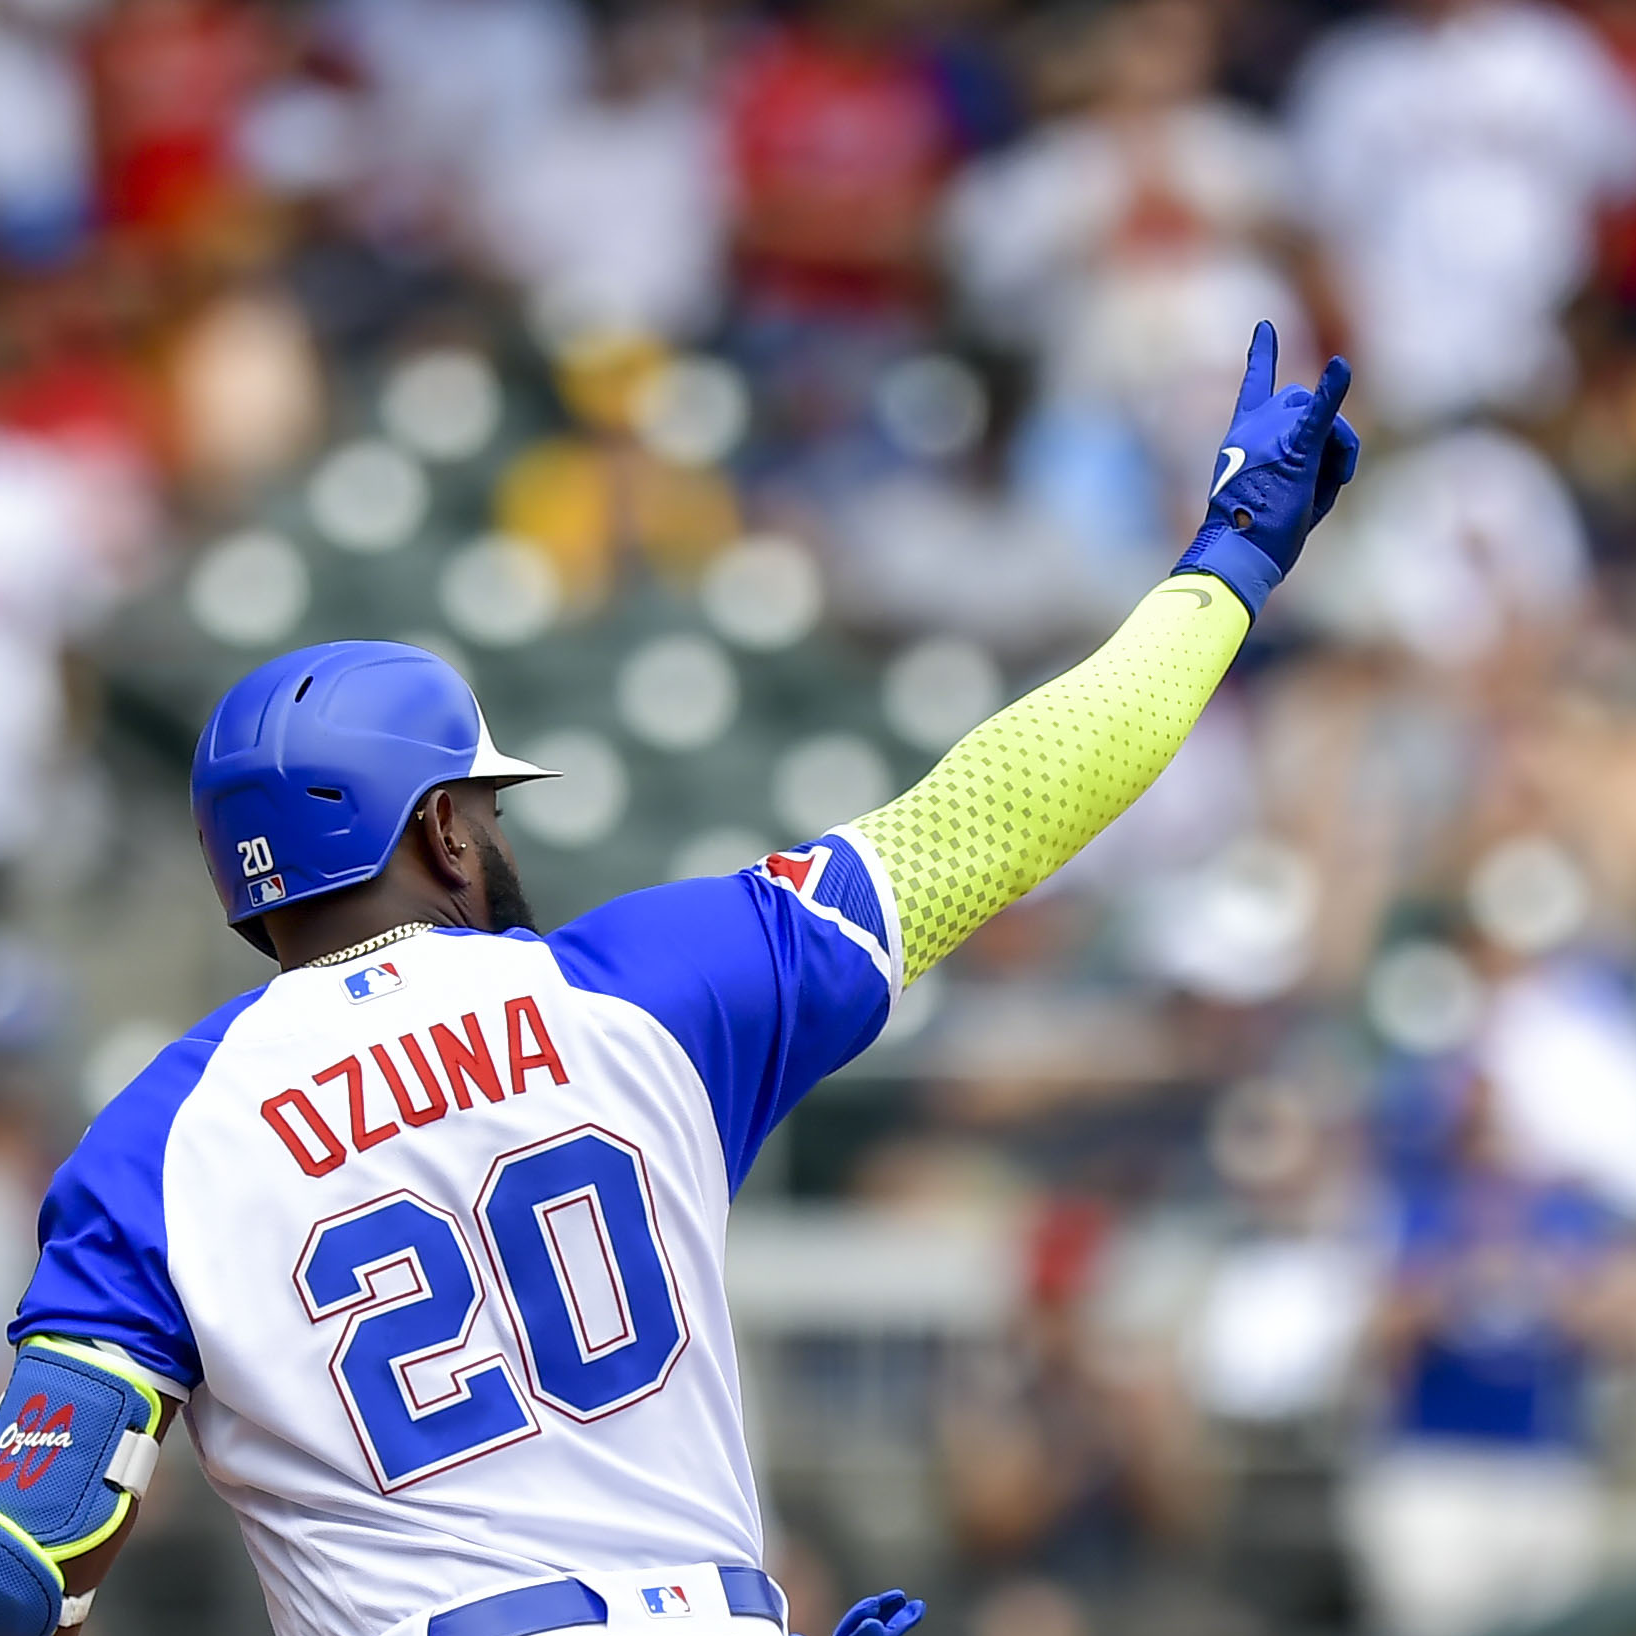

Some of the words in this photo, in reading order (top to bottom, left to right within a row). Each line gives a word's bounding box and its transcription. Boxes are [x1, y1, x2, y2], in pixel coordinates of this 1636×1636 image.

[236, 836, 274, 878] 20
[260, 995, 570, 1179] OZUNA
[292, 1122, 691, 1495] 20
